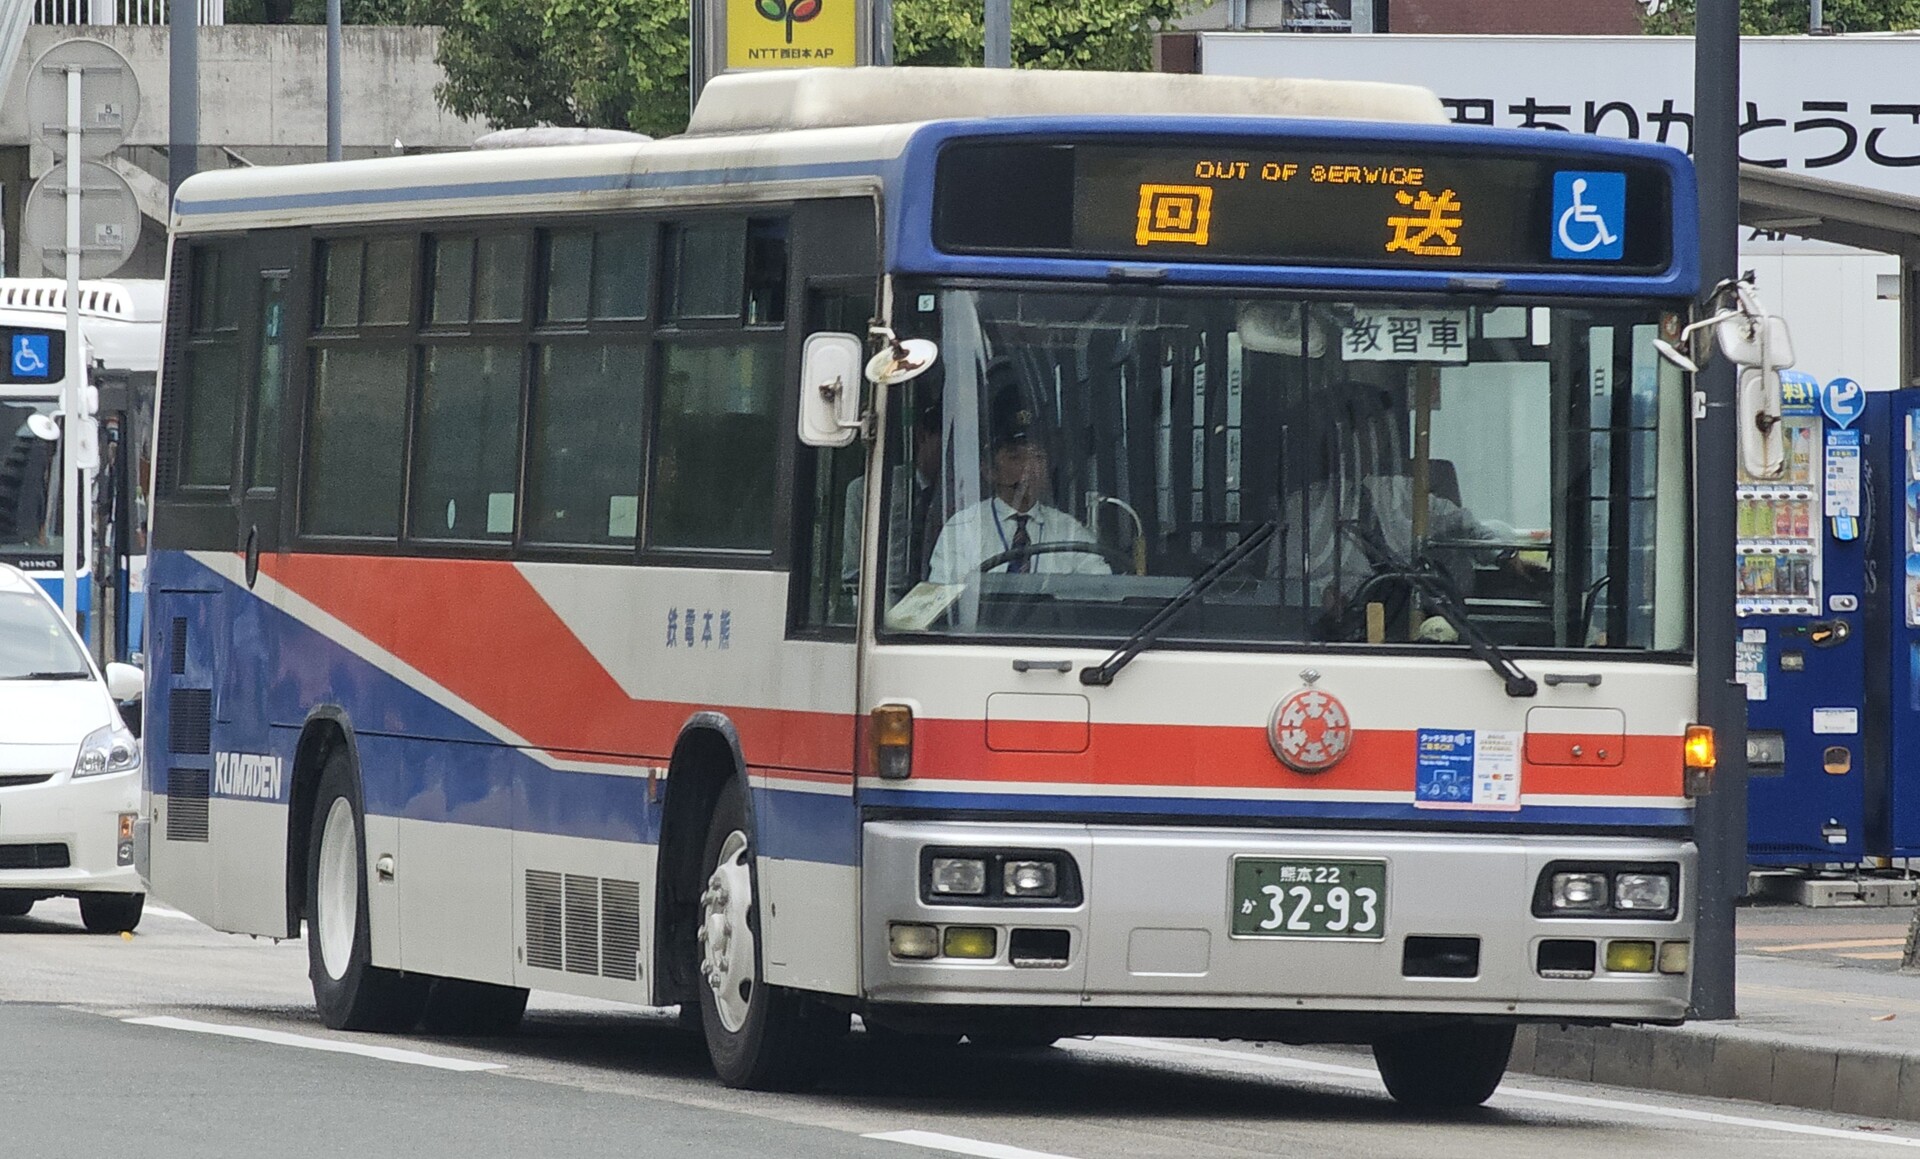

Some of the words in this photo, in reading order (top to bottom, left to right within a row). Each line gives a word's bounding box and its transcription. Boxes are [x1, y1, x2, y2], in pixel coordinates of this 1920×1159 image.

[1195, 160, 1249, 180] OUT
[1262, 162, 1298, 181] OF
[1310, 165, 1424, 185] SERVICE
[1136, 183, 1213, 246] 回
[1385, 189, 1463, 256] 送
[1346, 316, 1463, 354] 教習車
[1830, 381, 1858, 414] ピ
[19, 560, 57, 568] HINO
[214, 752, 282, 799] KUMADEN
[1241, 898, 1257, 914] か
[1260, 885, 1377, 932] 32-93
